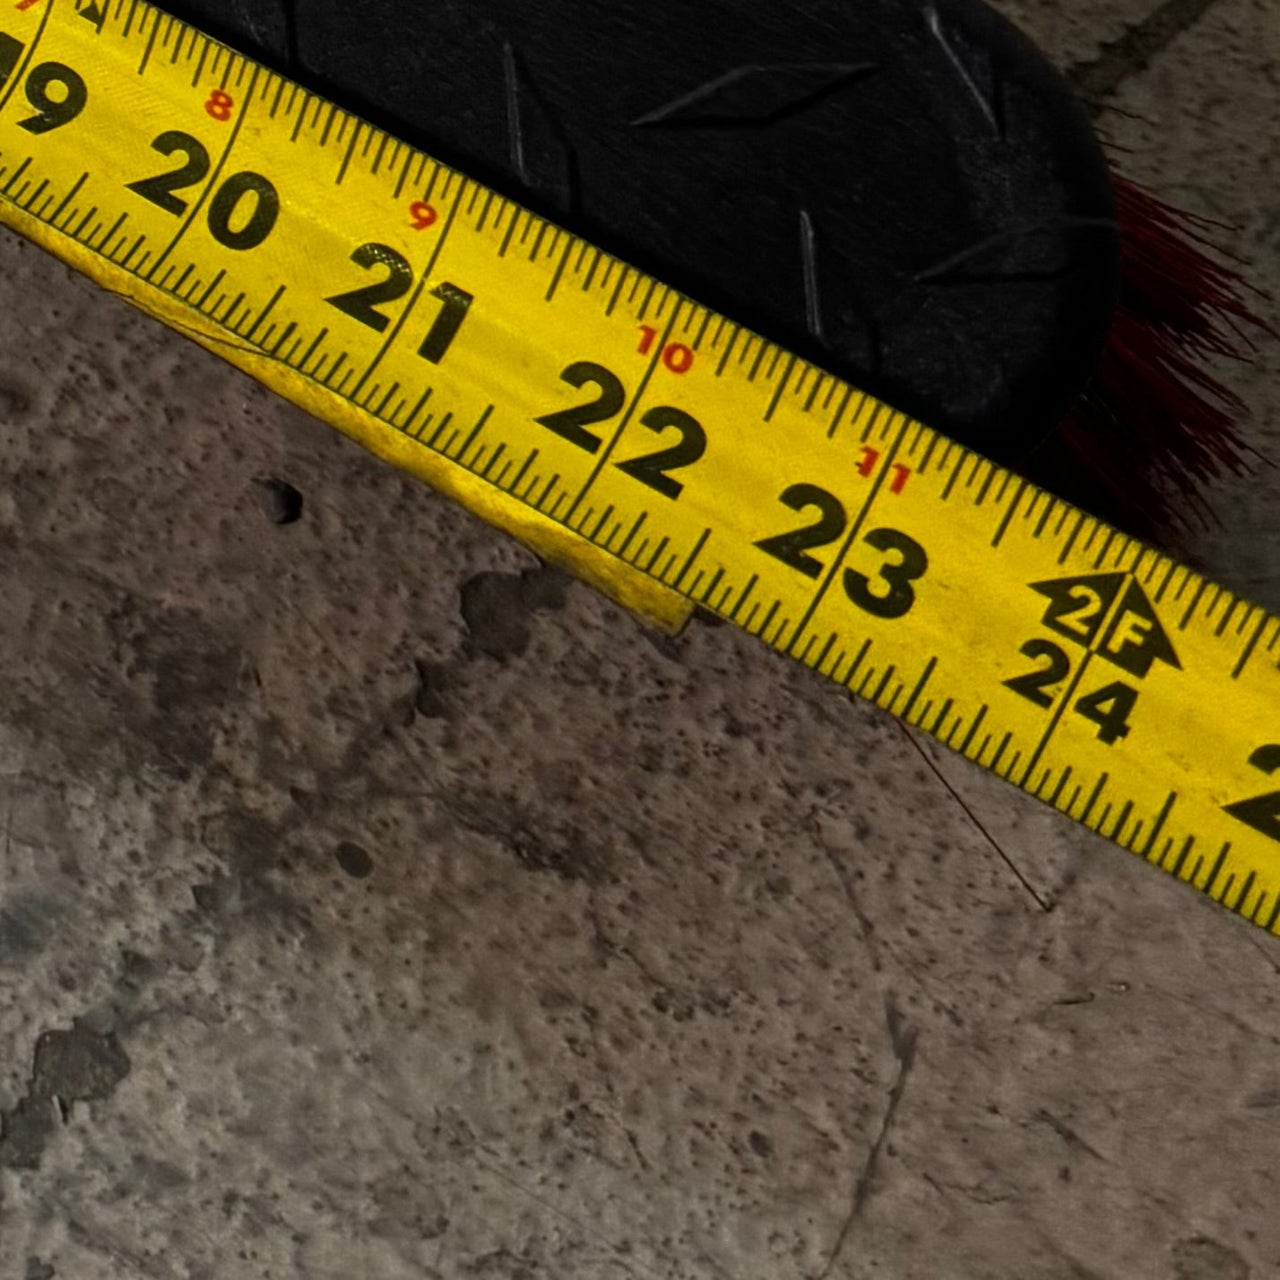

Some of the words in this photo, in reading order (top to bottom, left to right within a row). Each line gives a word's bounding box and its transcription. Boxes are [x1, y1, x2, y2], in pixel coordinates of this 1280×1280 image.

[204, 88, 234, 122] 8
[123, 129, 280, 251] 20
[407, 201, 438, 231] 9
[323, 242, 475, 365] 21
[637, 325, 694, 375] 10
[532, 360, 707, 501] 22
[854, 445, 912, 495] 11
[752, 482, 929, 620] 23
[1068, 584, 1153, 655] 2F
[1002, 637, 1139, 746] 24
